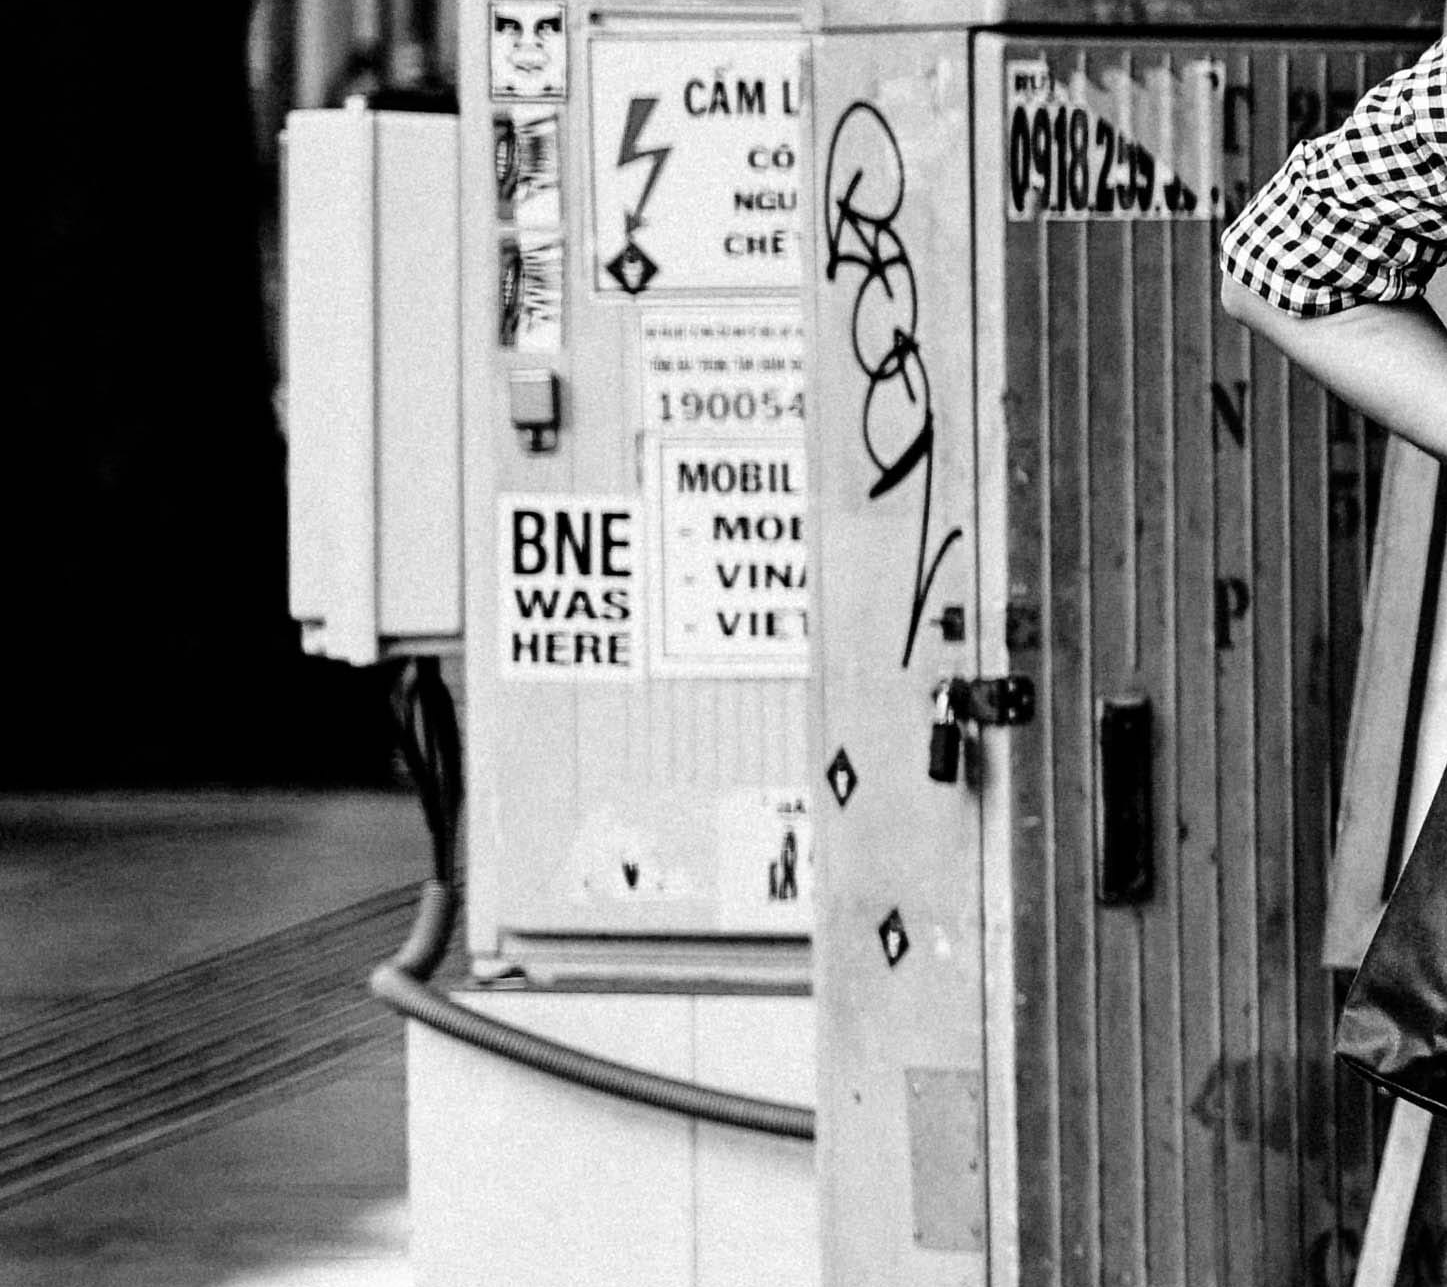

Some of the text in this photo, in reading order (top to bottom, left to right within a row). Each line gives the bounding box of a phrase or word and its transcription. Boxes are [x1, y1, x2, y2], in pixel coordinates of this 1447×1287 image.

[512, 510, 632, 577] BNE
[514, 589, 631, 621] WAS
[512, 631, 631, 666] HERE
